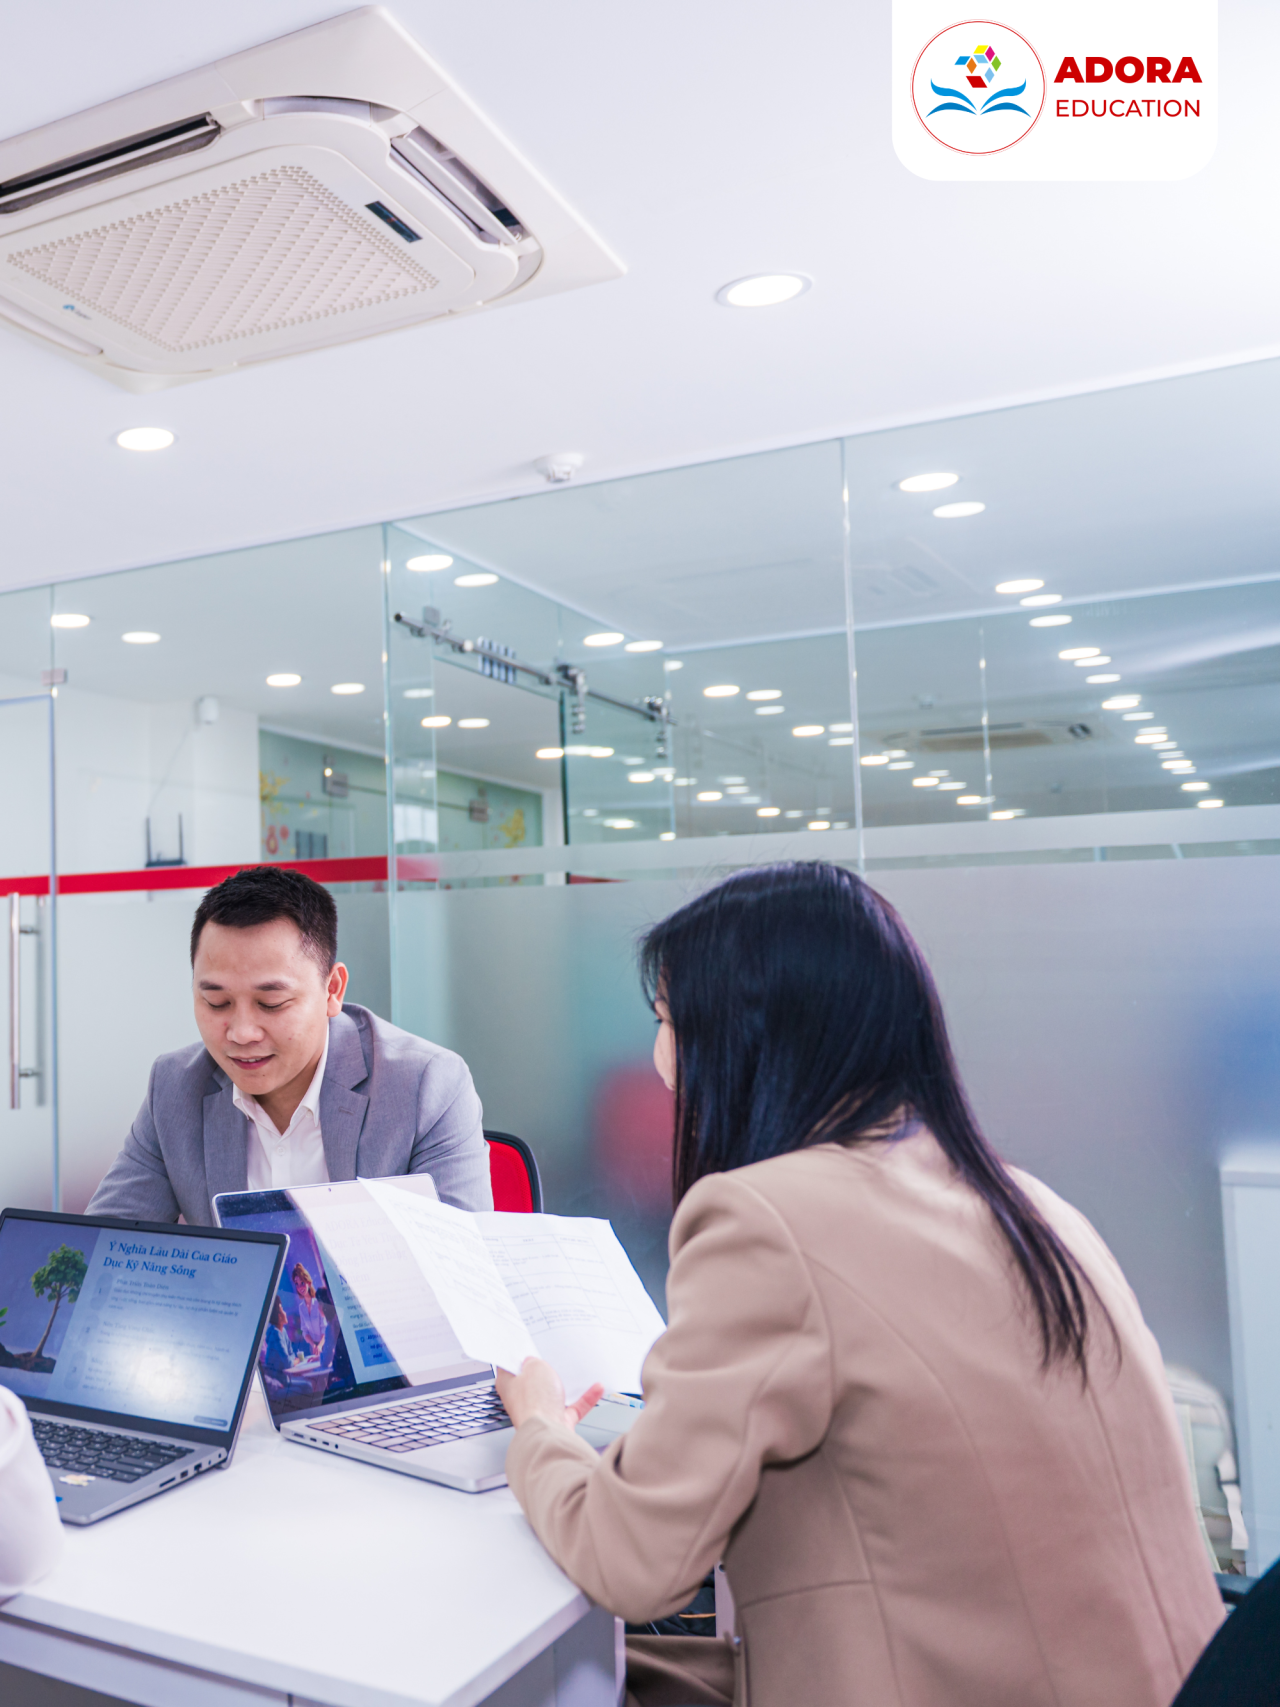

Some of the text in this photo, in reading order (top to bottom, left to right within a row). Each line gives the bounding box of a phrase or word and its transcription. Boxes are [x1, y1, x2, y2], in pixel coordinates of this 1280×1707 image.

[324, 1219, 359, 1232] ADORA
[117, 1241, 148, 1256] Nghĩa
[170, 1247, 190, 1260] Dài
[212, 1251, 239, 1265] Giáo
[102, 1256, 198, 1280] Dục Kỹ Năng Sống
